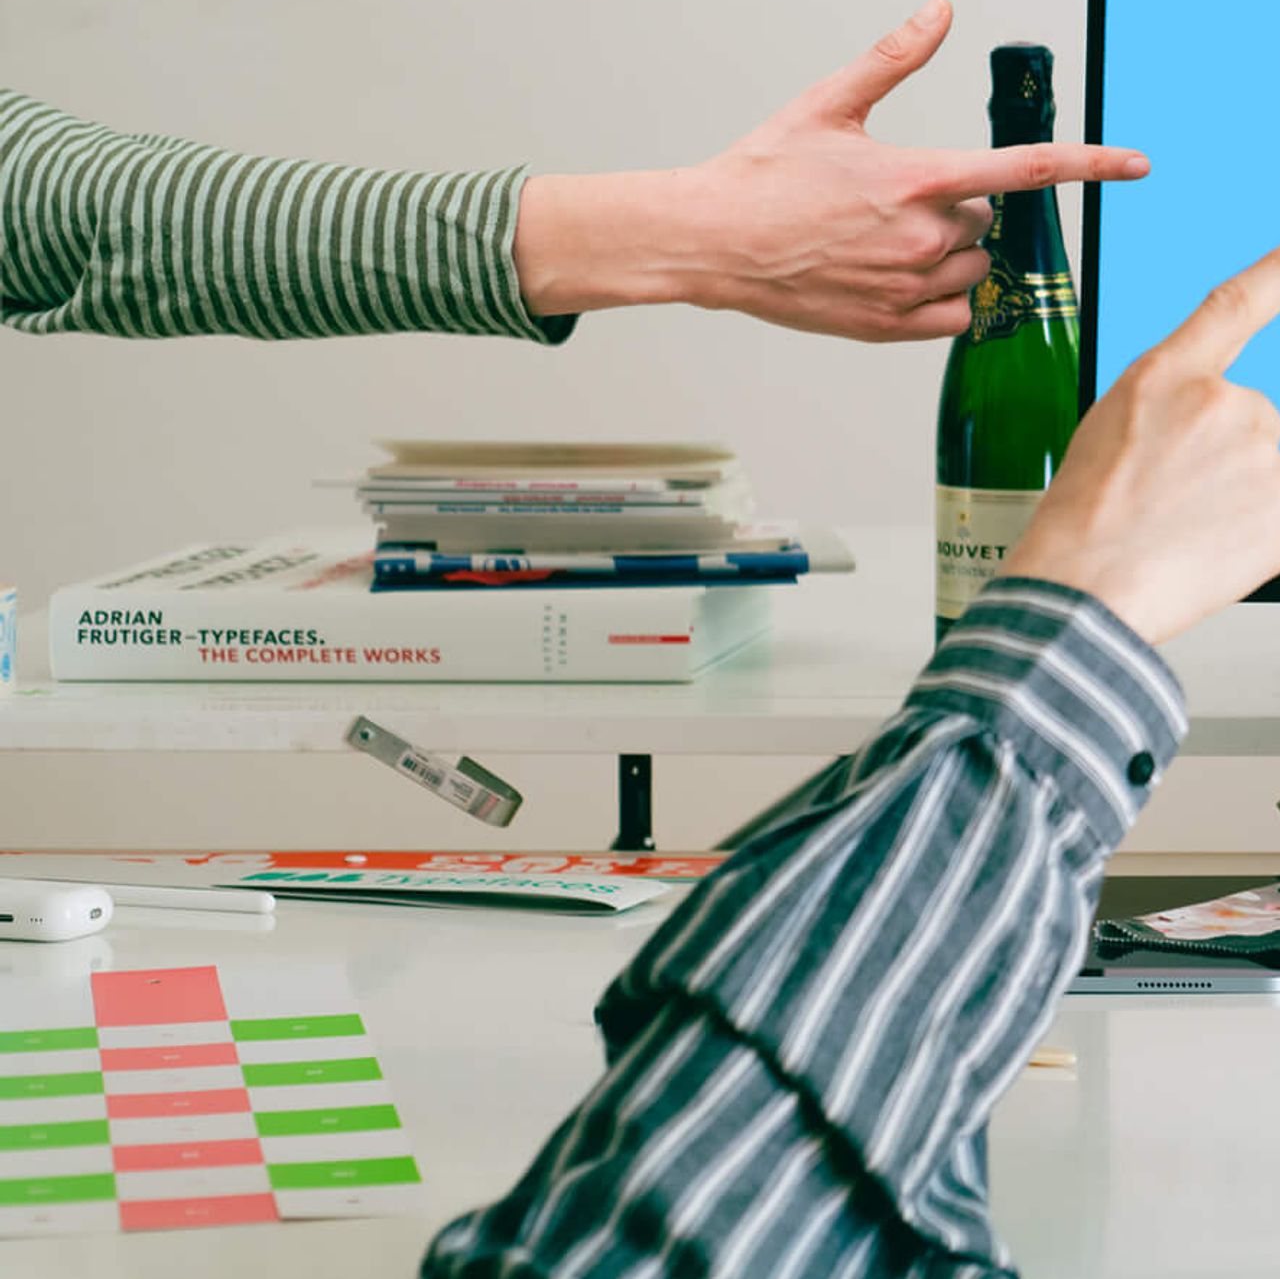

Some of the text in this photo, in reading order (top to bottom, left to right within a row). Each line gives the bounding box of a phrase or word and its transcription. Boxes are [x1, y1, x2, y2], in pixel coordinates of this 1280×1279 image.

[78, 610, 163, 626] ADRIAN
[199, 648, 441, 664] THE COMPLETE WORKS
